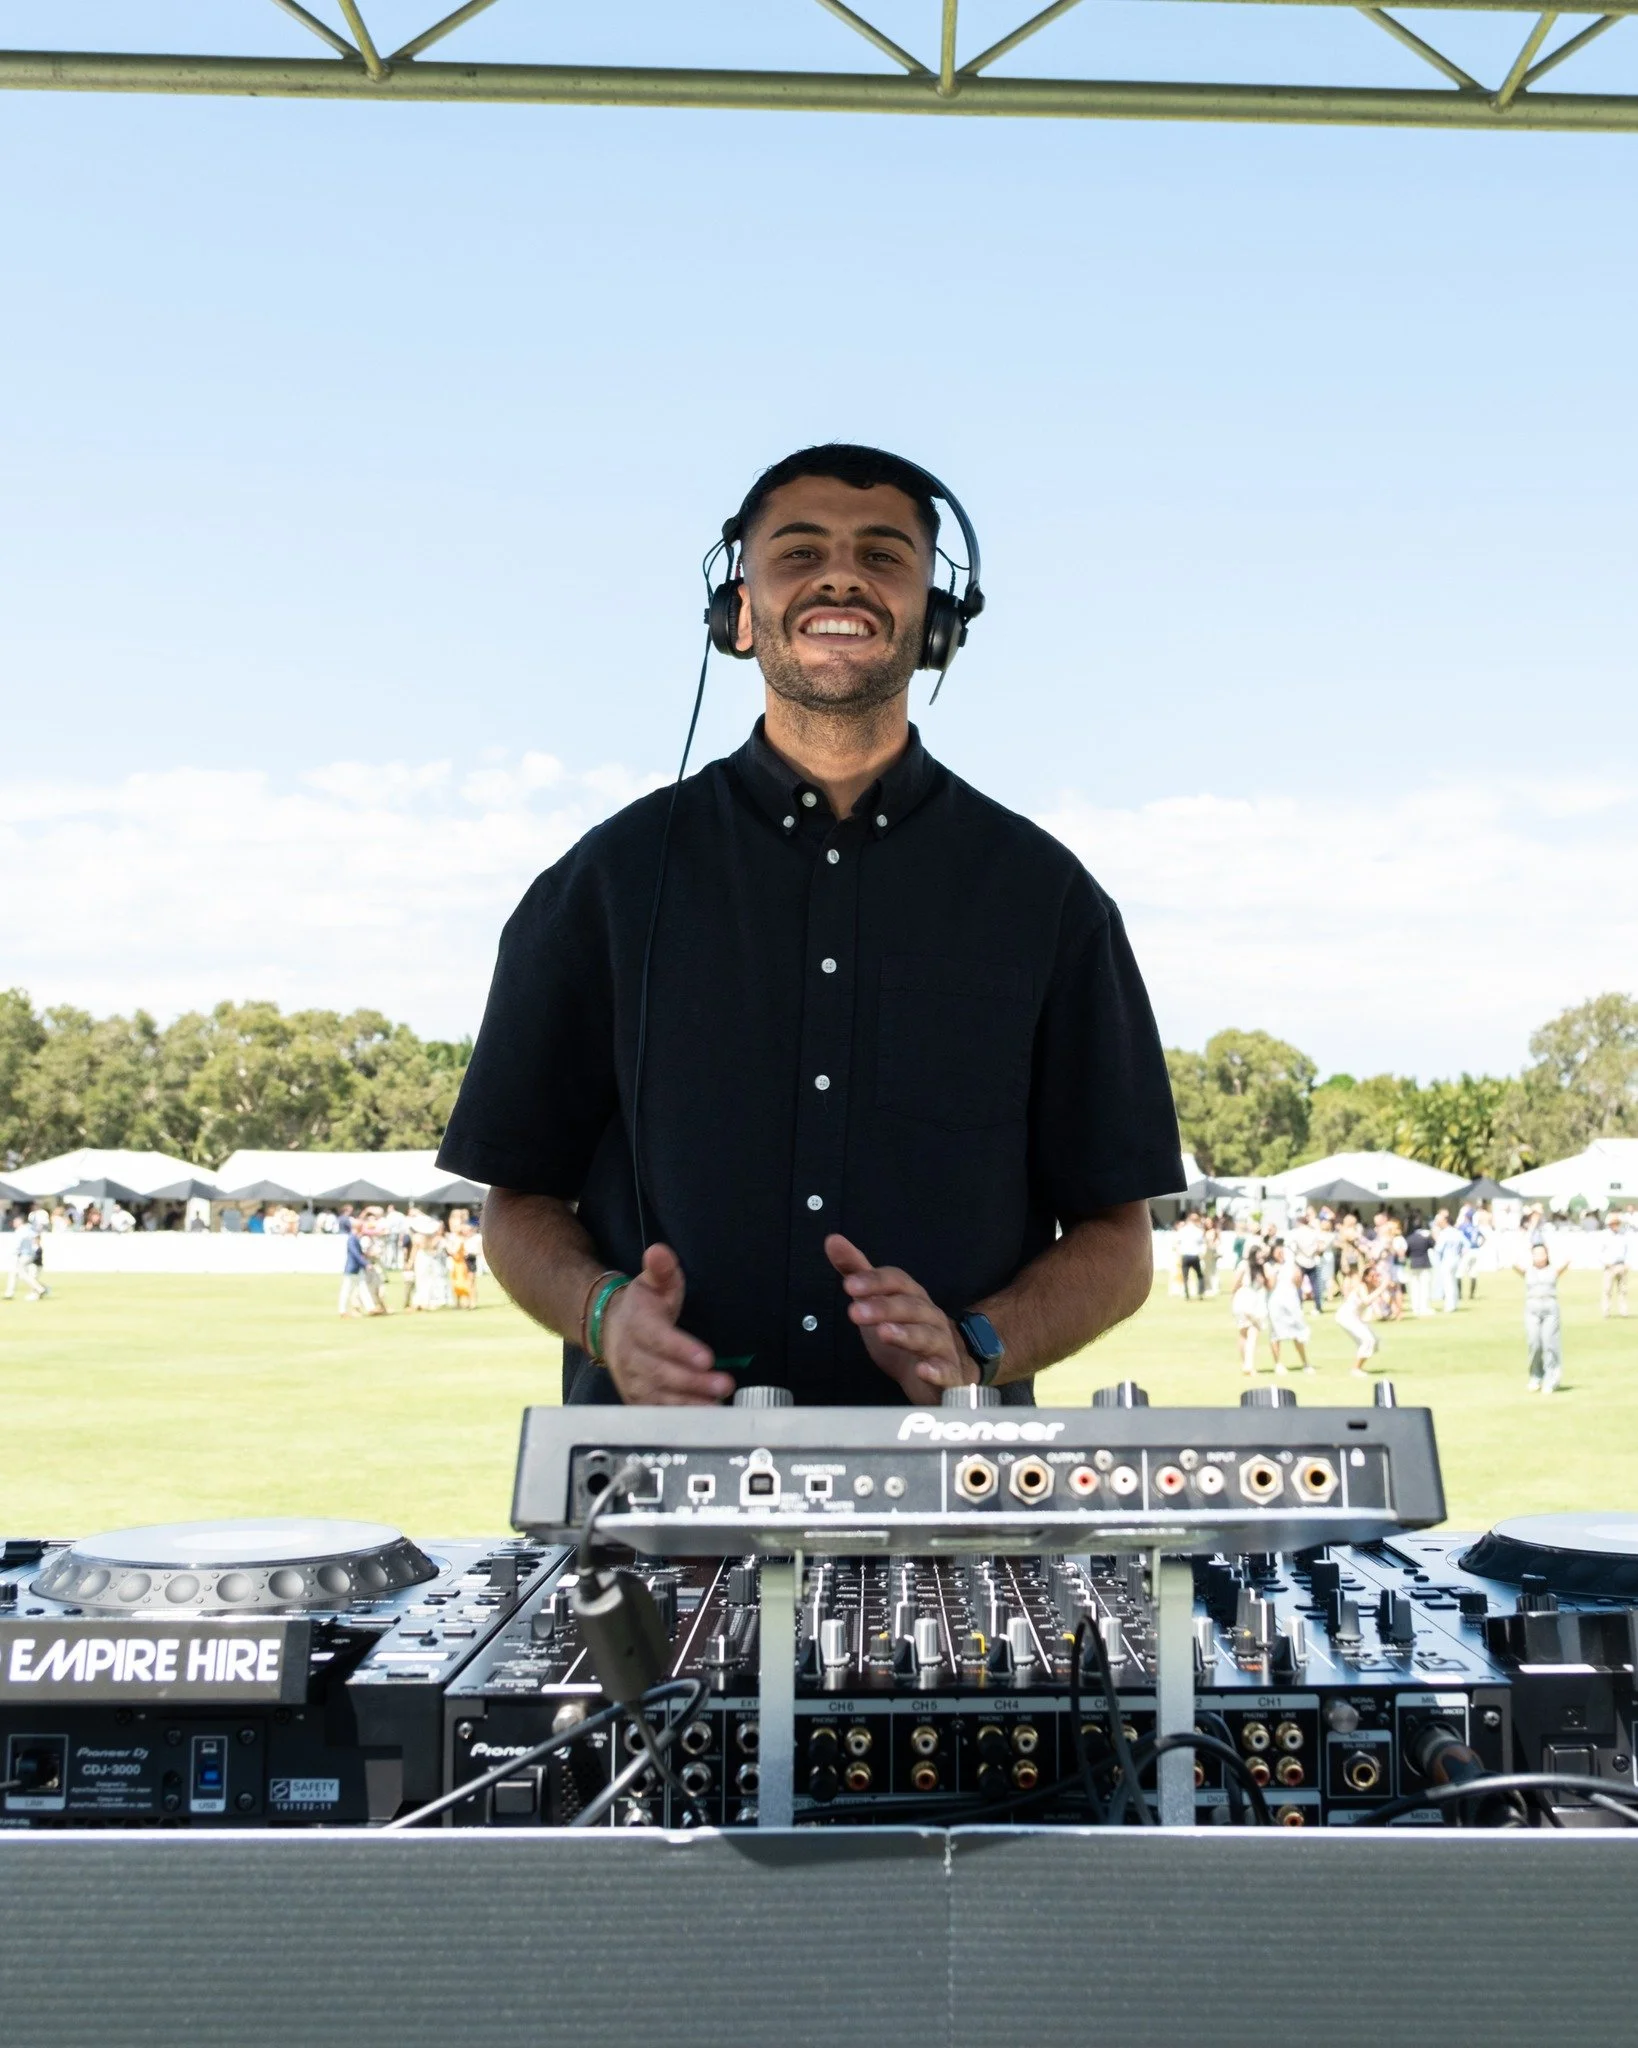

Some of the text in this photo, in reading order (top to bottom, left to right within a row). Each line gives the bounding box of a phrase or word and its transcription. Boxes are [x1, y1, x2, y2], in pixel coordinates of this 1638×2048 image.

[898, 1412, 1065, 1441] Pioneer
[9, 1639, 281, 1682] EMPIRE HIRE
[828, 1701, 855, 1712] CH6
[911, 1701, 938, 1711] CH5
[994, 1700, 1019, 1710] CH4
[1257, 1697, 1281, 1707] CH1
[76, 1747, 130, 1758] Pioneer
[81, 1764, 141, 1776] CDJ-3000
[293, 1782, 336, 1792] SAFETY
[199, 1801, 218, 1811] USB
